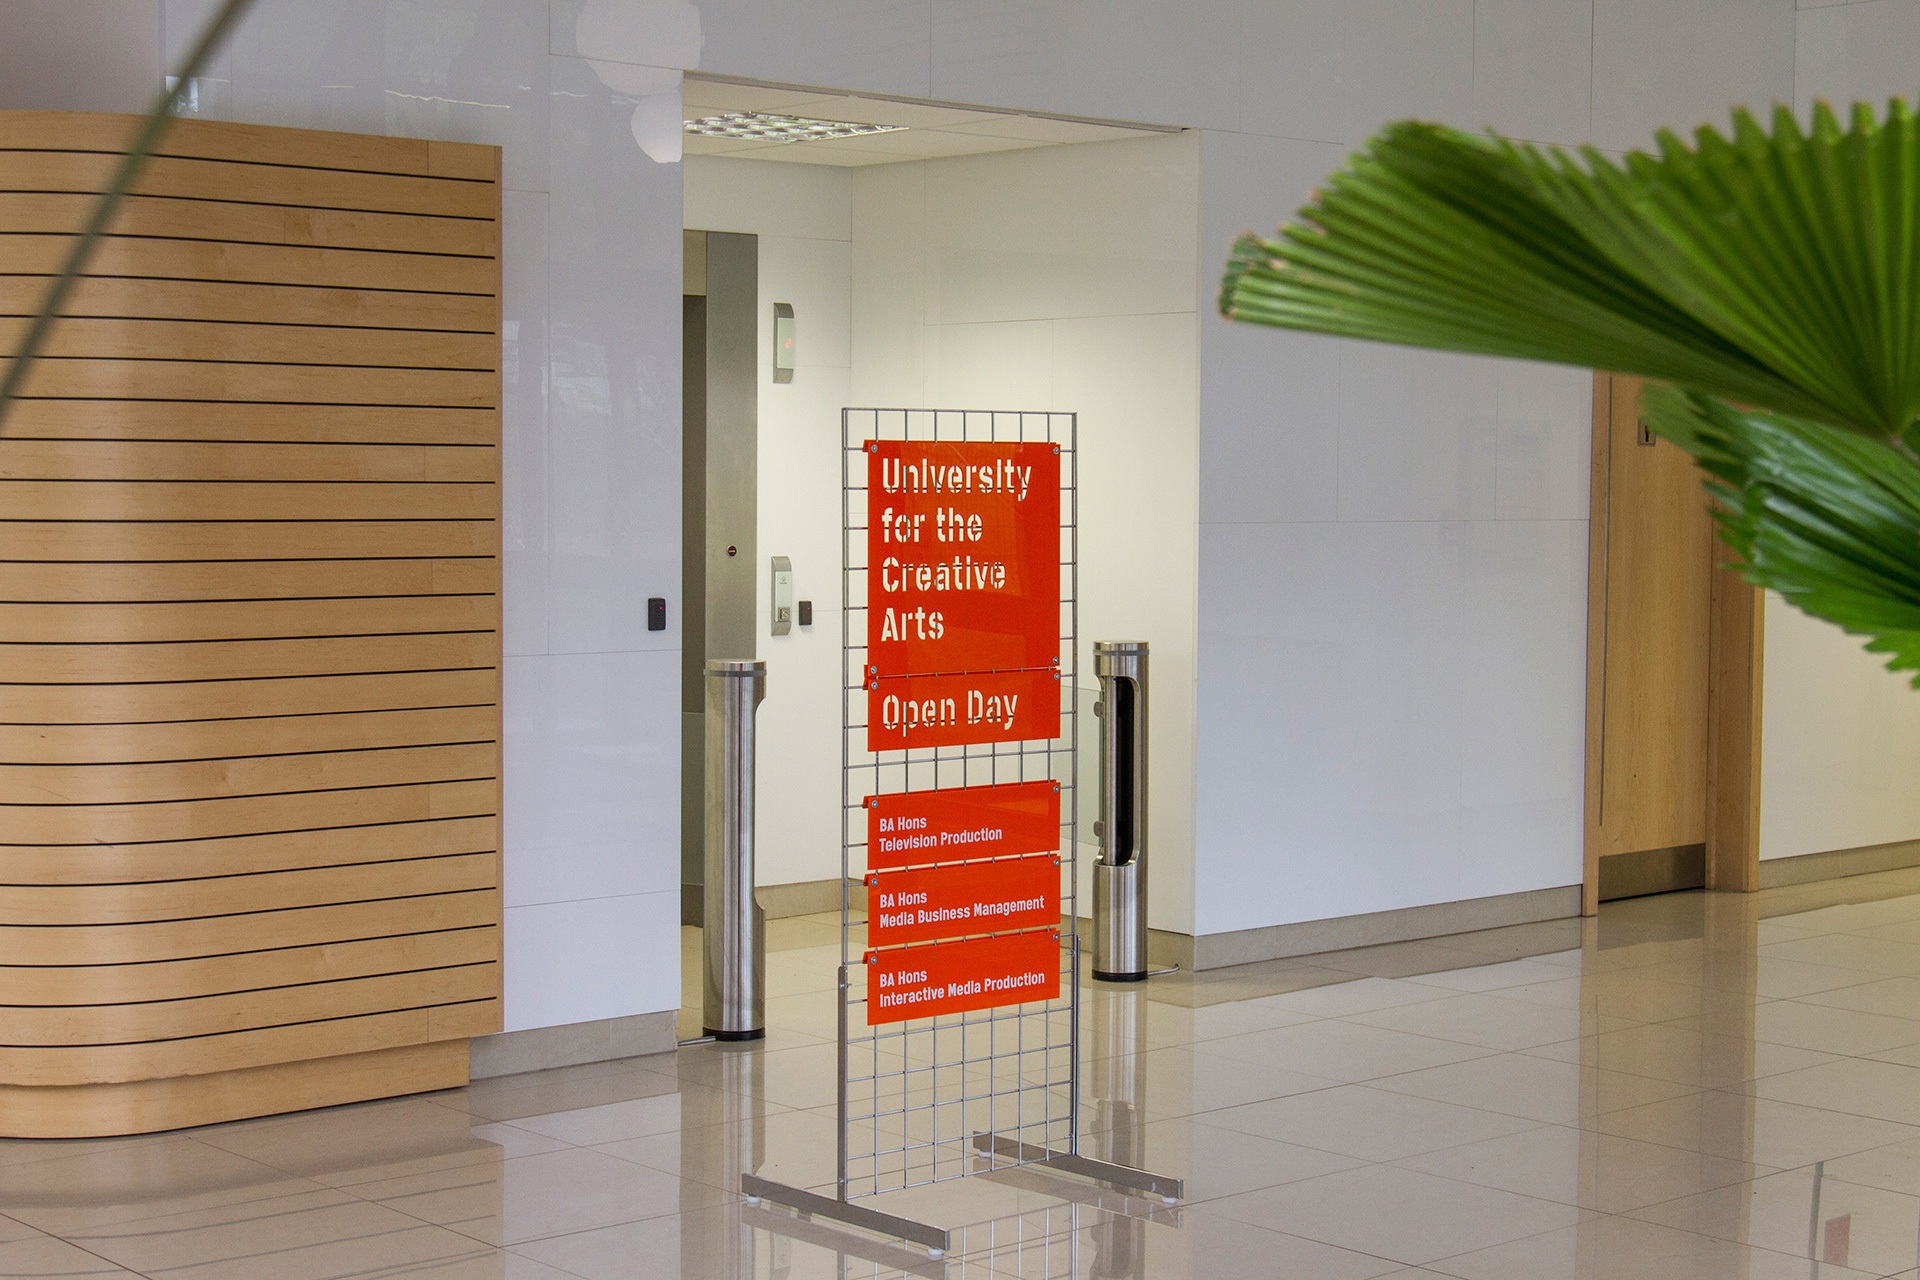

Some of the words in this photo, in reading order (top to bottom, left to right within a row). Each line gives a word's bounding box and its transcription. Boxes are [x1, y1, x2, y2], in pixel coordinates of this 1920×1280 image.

[882, 457, 1032, 501] University
[881, 507, 925, 543] for
[936, 507, 983, 543] the
[882, 556, 1006, 593] Creative
[881, 606, 945, 642] Arts
[882, 694, 956, 737] Open
[967, 690, 1018, 731] Day
[879, 818, 895, 833] BA
[897, 816, 927, 831] Hons
[879, 833, 937, 852] Television
[940, 827, 1002, 847] Production
[879, 893, 895, 909] BA
[898, 891, 928, 906] Hons
[879, 911, 914, 928] Media
[918, 906, 971, 924] Business
[973, 895, 1045, 917] Management
[879, 972, 895, 988] BA
[898, 970, 928, 985] Hons
[879, 987, 944, 1008] Interactive
[947, 980, 981, 998] Media
[984, 971, 1045, 991] Production
